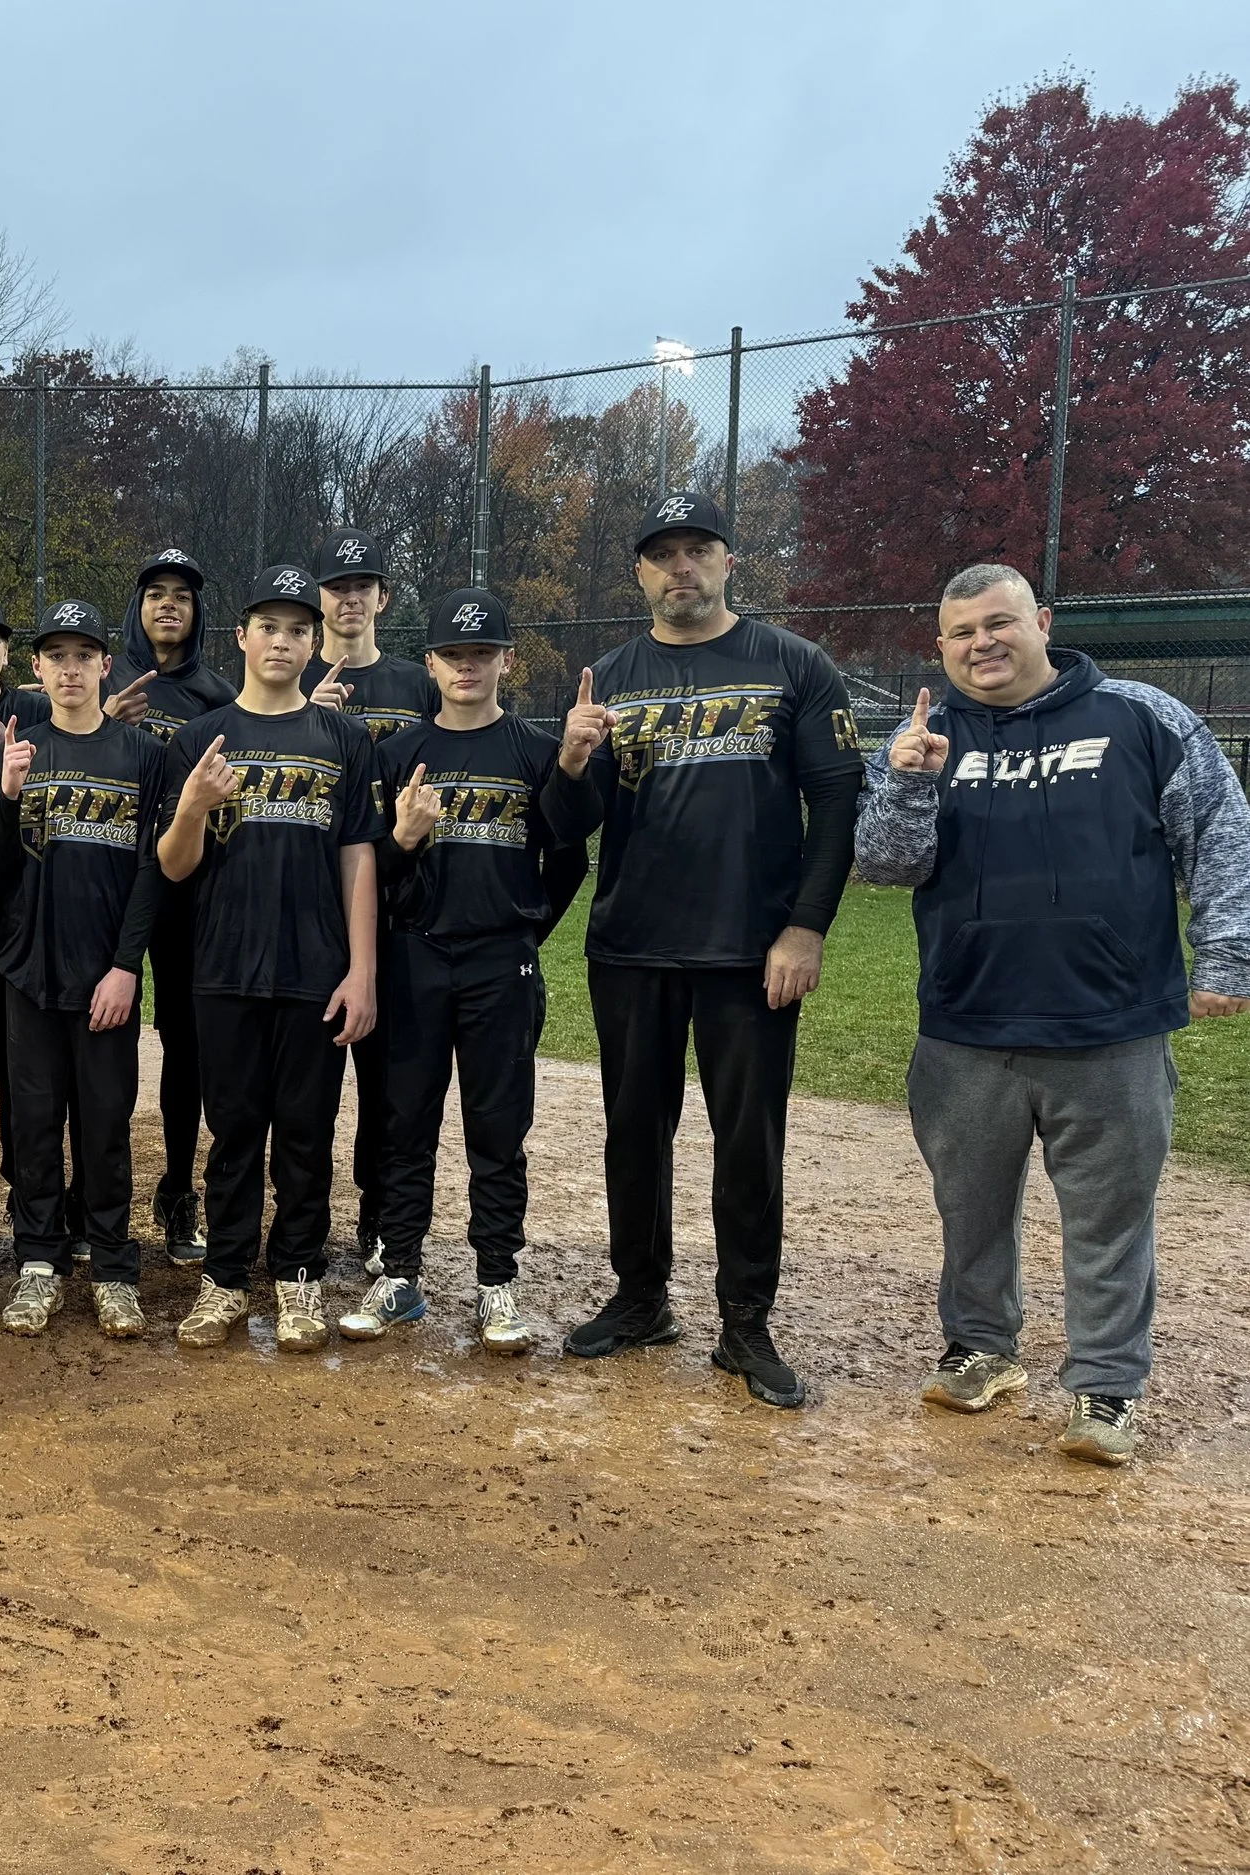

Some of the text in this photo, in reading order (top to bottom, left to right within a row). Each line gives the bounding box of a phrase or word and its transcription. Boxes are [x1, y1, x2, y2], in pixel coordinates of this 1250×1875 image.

[656, 496, 695, 523] RE
[336, 539, 368, 564] RE
[272, 570, 307, 595] RE
[53, 603, 87, 626] RE
[452, 603, 488, 631] RE
[609, 685, 695, 705] ROCKLAND
[611, 696, 783, 749] ELITE
[661, 727, 774, 763] Baseball
[1001, 743, 1066, 758] ROCKAND
[952, 737, 1111, 781] ELITE
[26, 770, 85, 783] OCKLAND
[226, 766, 341, 803] LITE
[20, 786, 139, 826] ELITE
[54, 812, 138, 844] Baseball
[439, 815, 526, 842] Baseball
